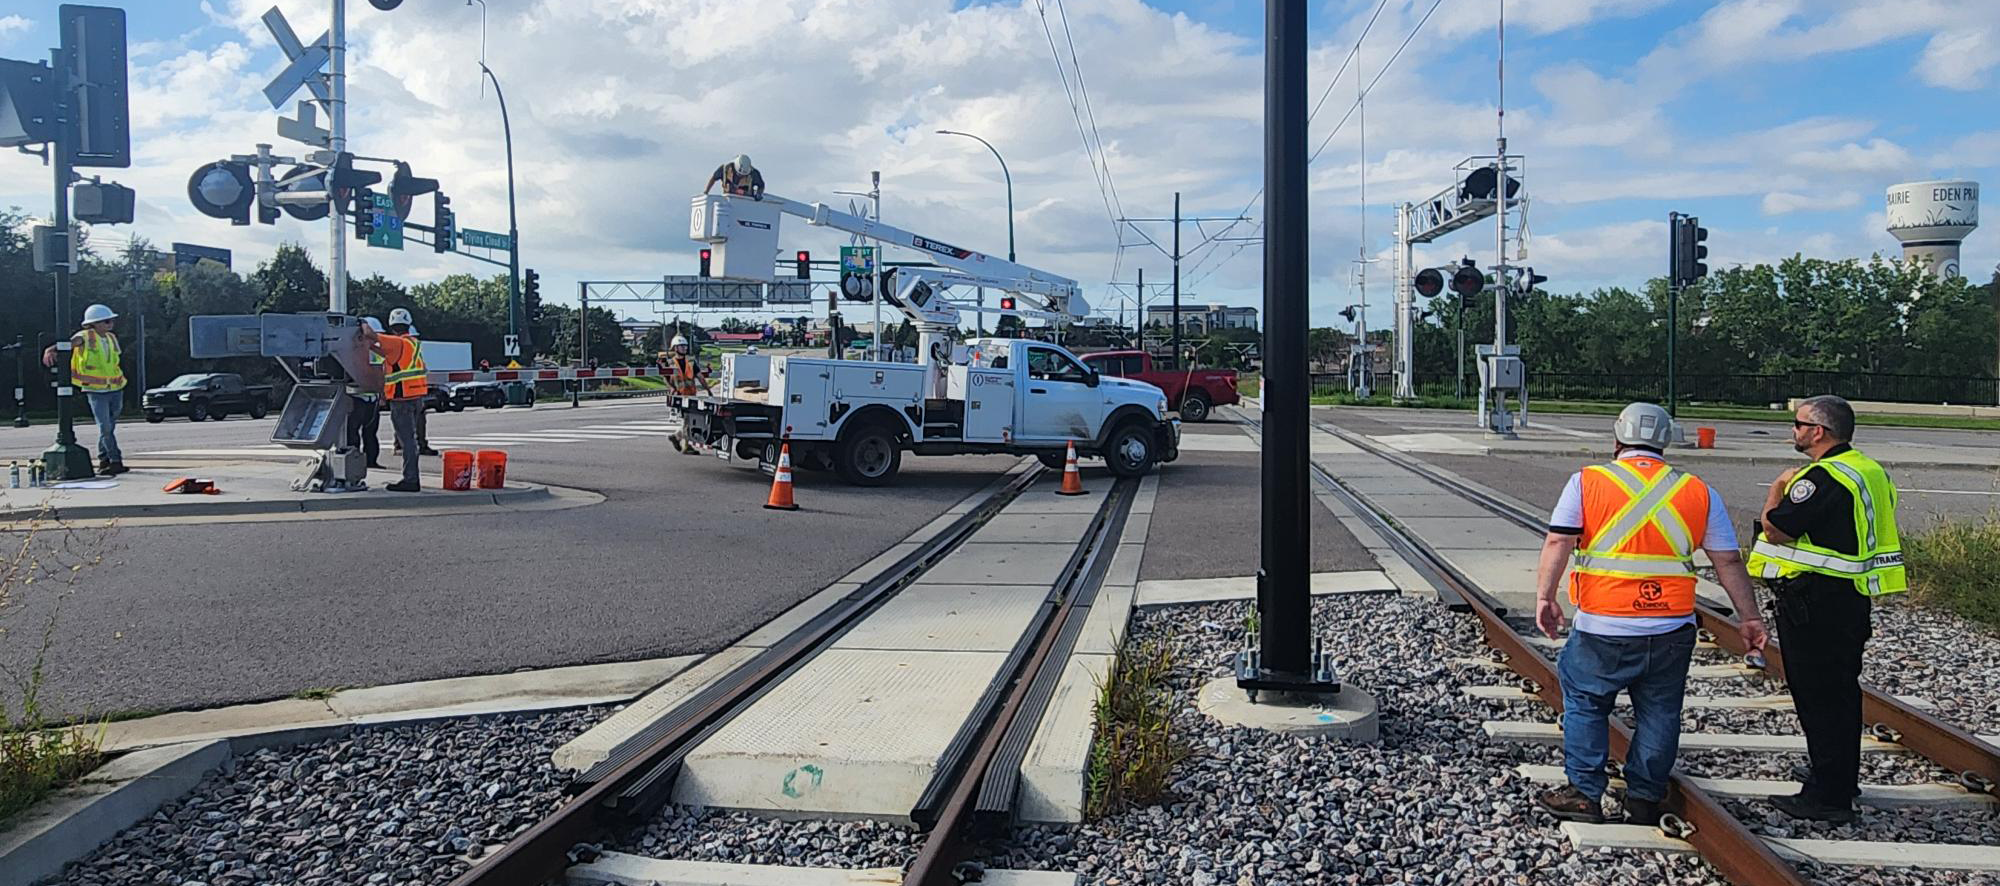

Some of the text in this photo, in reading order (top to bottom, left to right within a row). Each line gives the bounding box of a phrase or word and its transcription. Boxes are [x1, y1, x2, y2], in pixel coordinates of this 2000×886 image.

[1933, 187, 1960, 202] EDEN
[464, 232, 484, 247] Flying
[485, 235, 501, 249] Cloud
[925, 240, 955, 255] TEREX
[852, 248, 871, 256] EST
